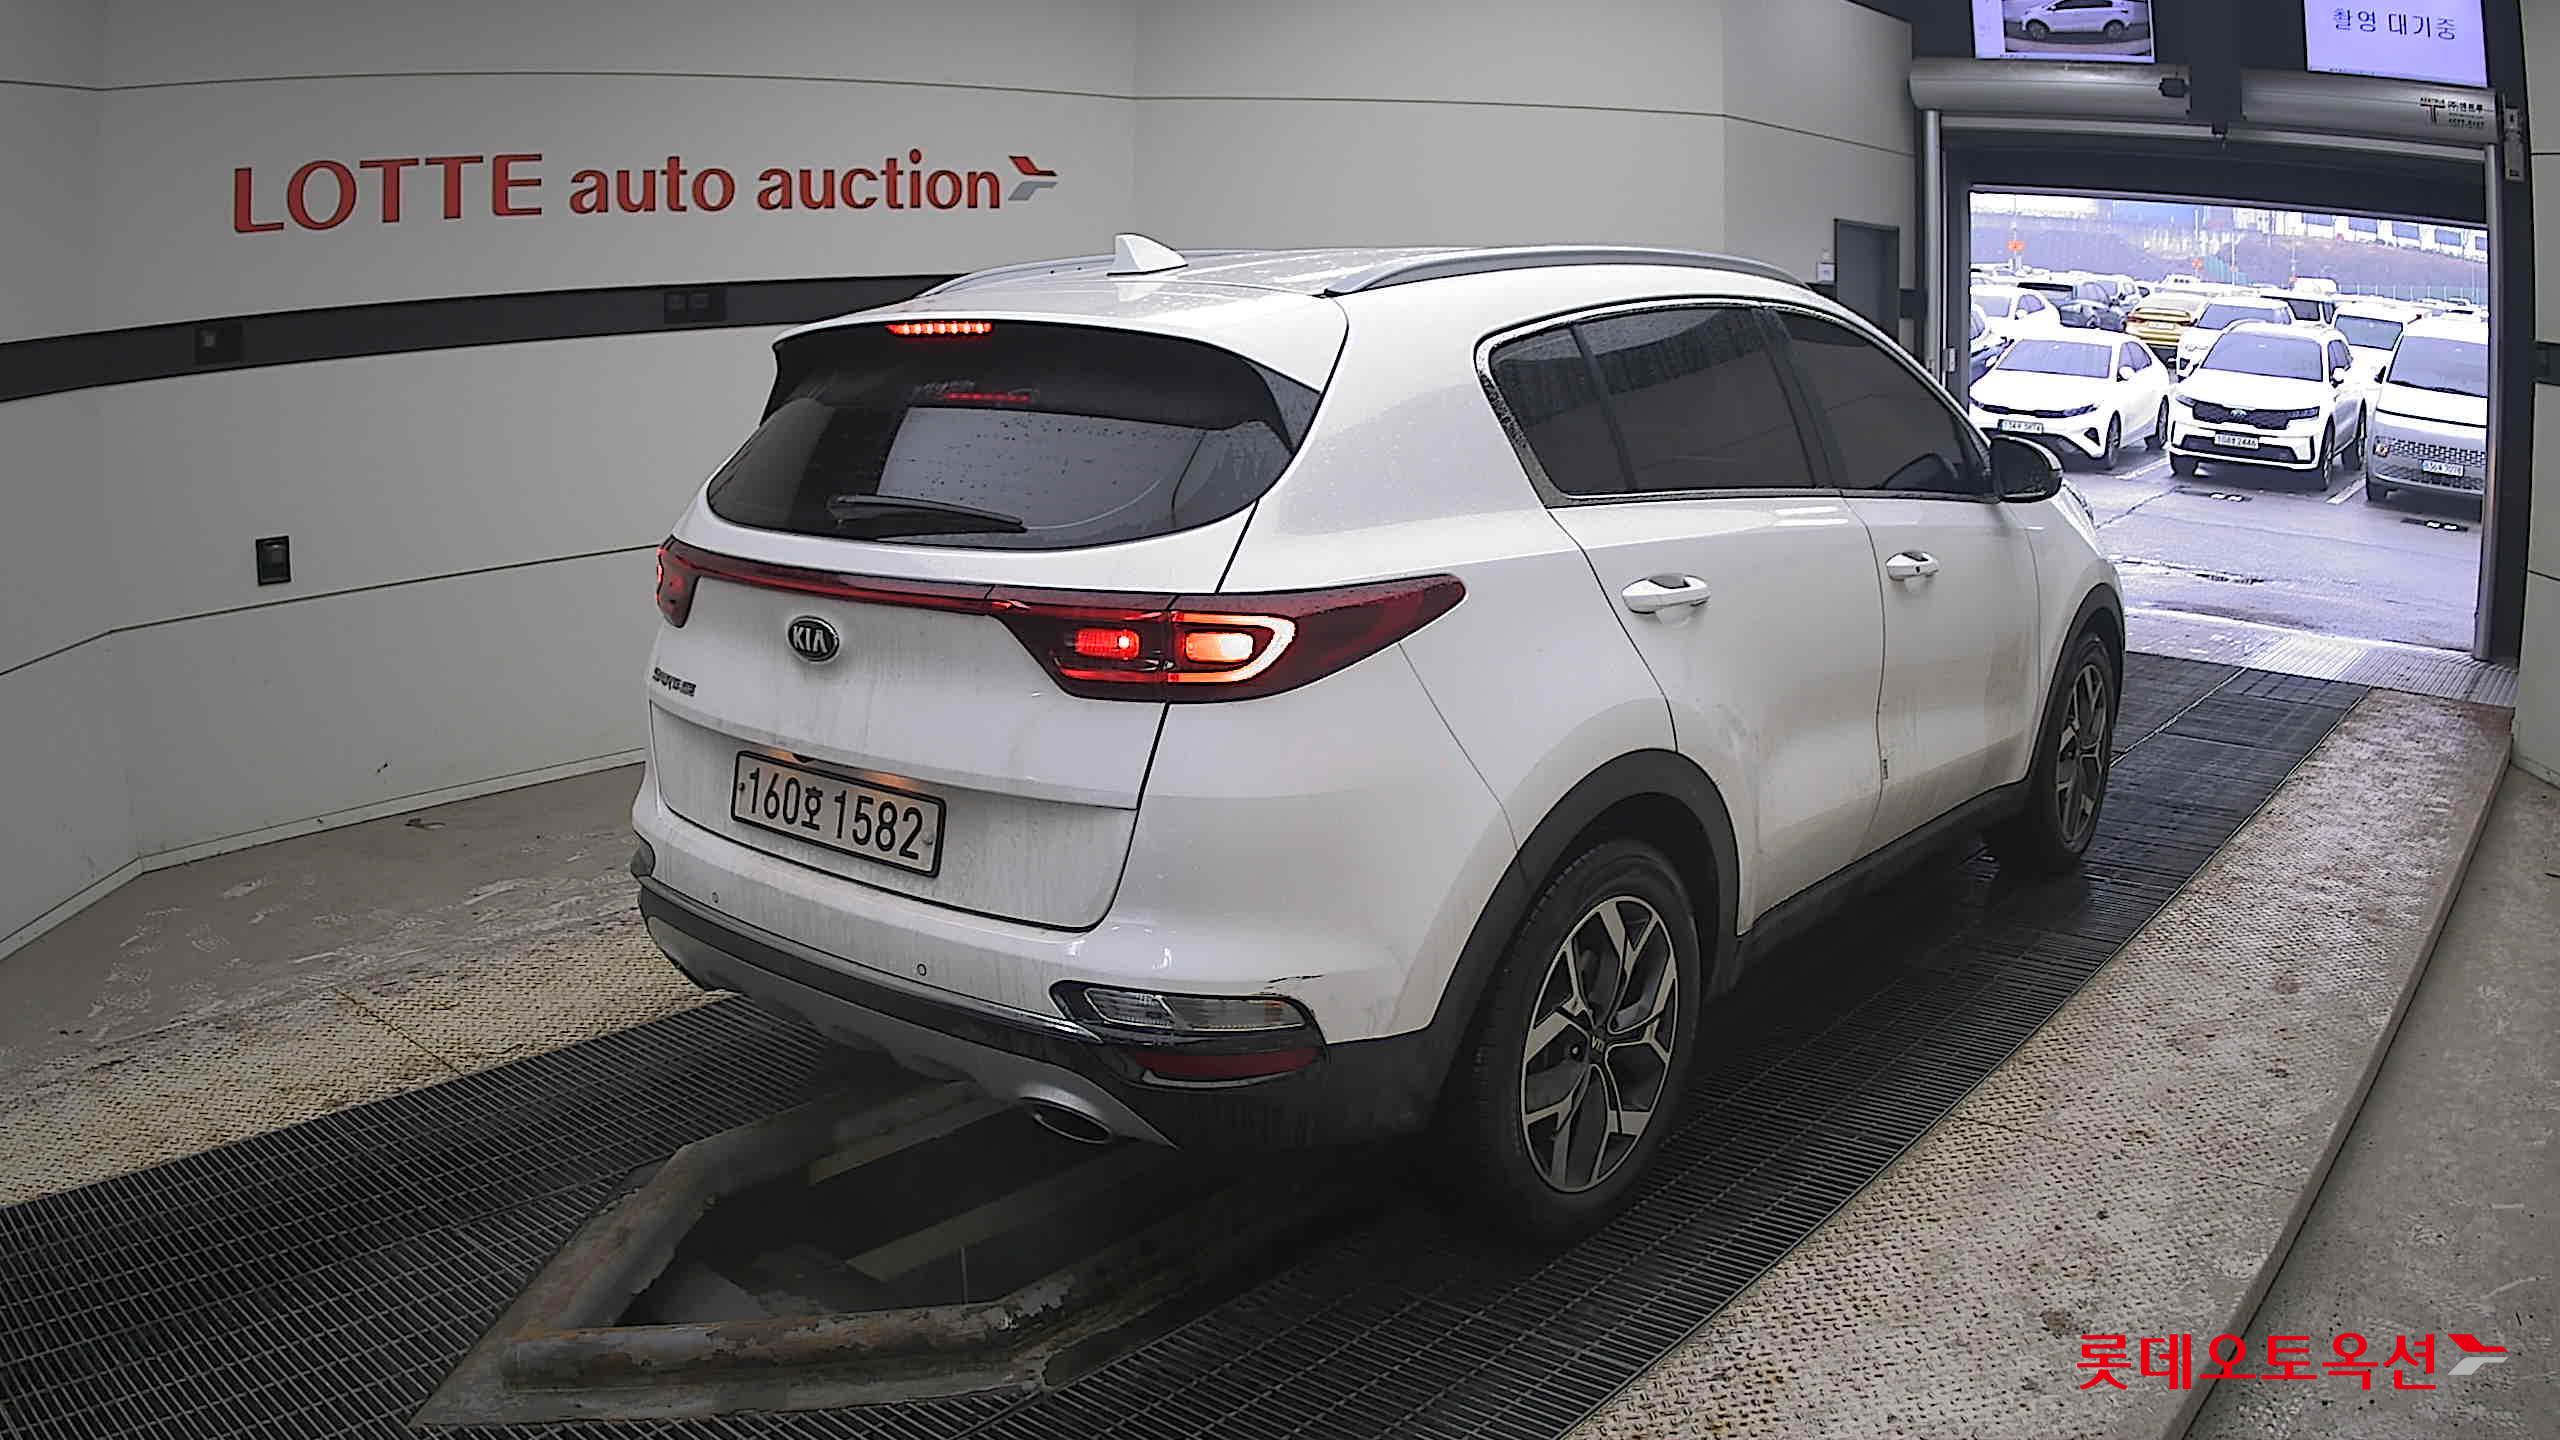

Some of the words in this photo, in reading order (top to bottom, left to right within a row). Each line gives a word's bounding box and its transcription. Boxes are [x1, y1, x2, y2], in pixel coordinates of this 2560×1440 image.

[2333, 7, 2378, 33] 촬영
[2387, 12, 2457, 41] 대기중
[233, 153, 545, 234] LOTTE
[569, 156, 737, 215] auto
[757, 150, 1002, 211] auction
[792, 625, 829, 654] KIA
[749, 766, 823, 831] 160호
[833, 788, 924, 861] 1582
